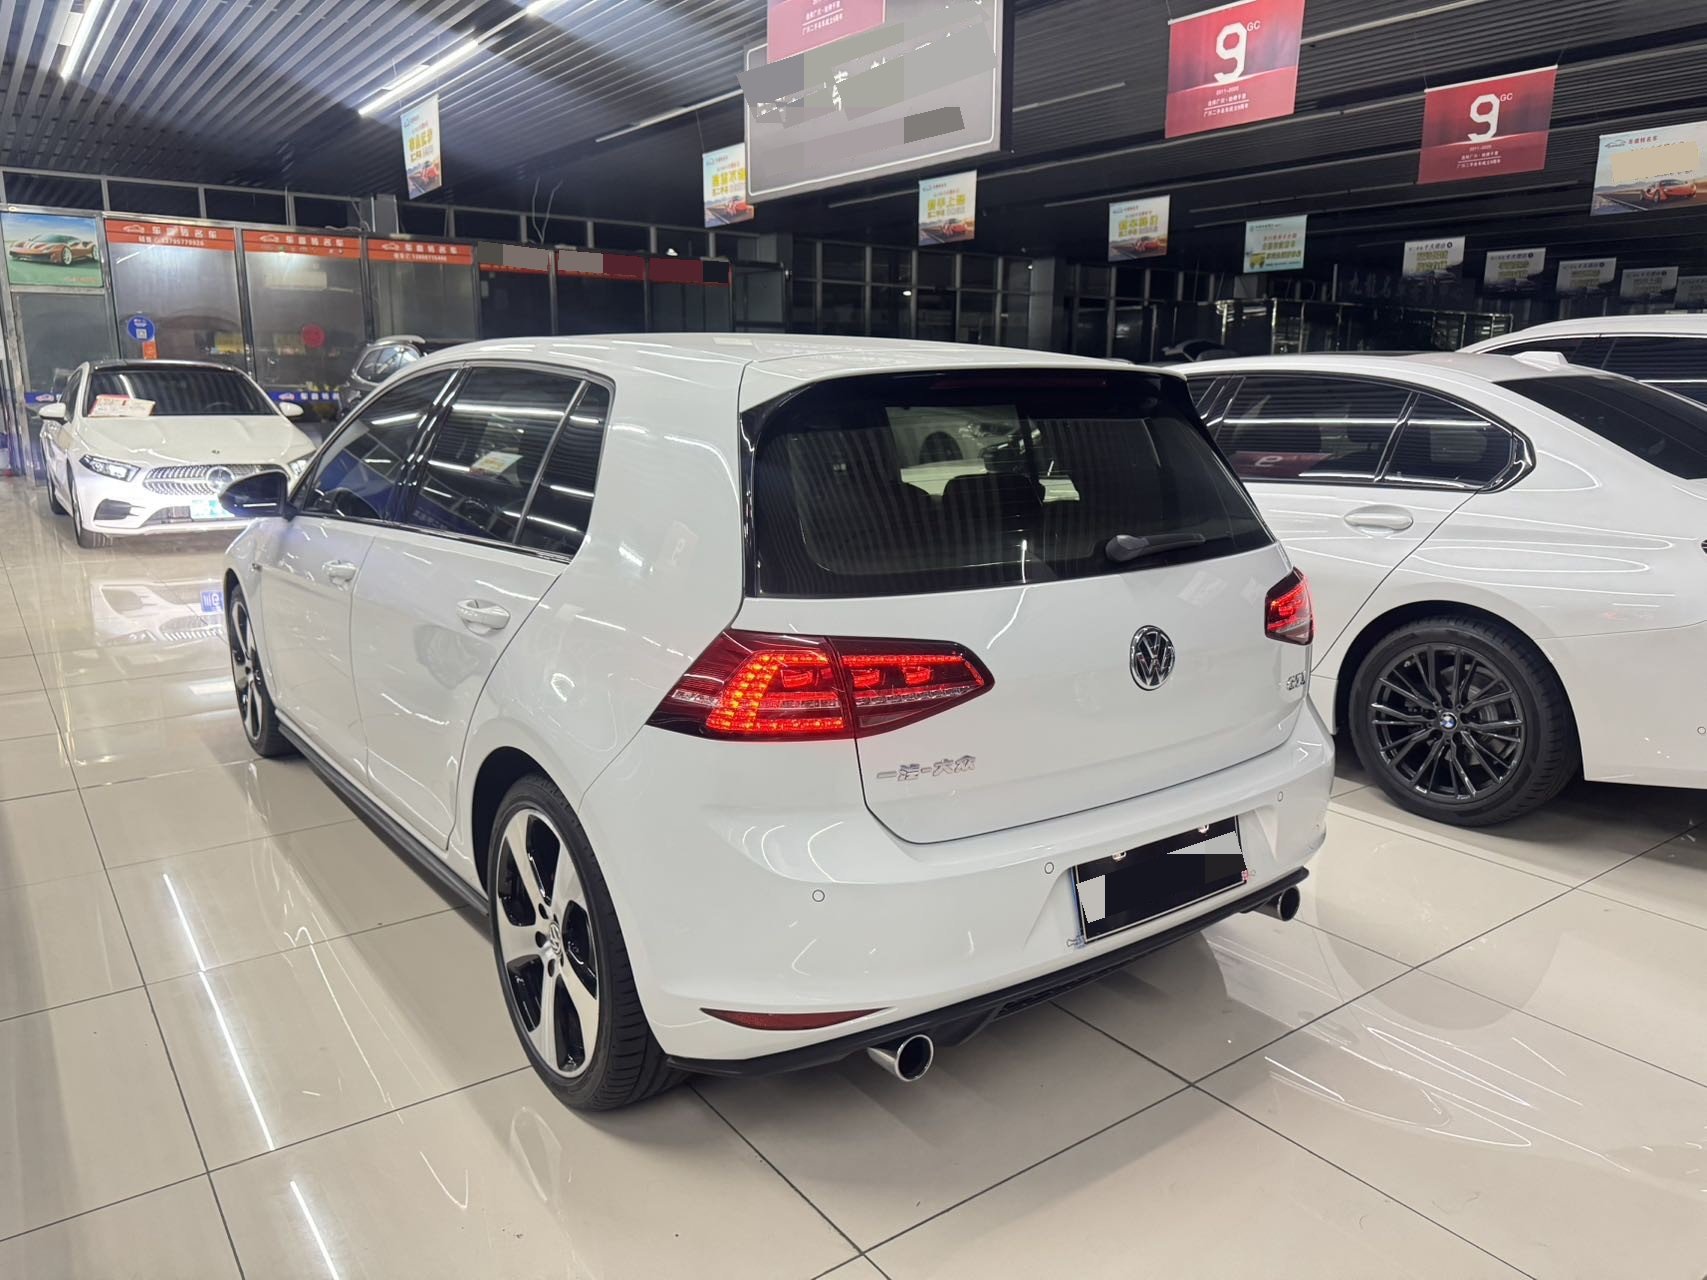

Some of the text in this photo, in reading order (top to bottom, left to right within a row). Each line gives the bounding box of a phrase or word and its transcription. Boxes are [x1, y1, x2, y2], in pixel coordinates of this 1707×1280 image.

[1214, 22, 1247, 84] 9
[1247, 21, 1260, 31] GC
[1467, 93, 1513, 143] 9 GC
